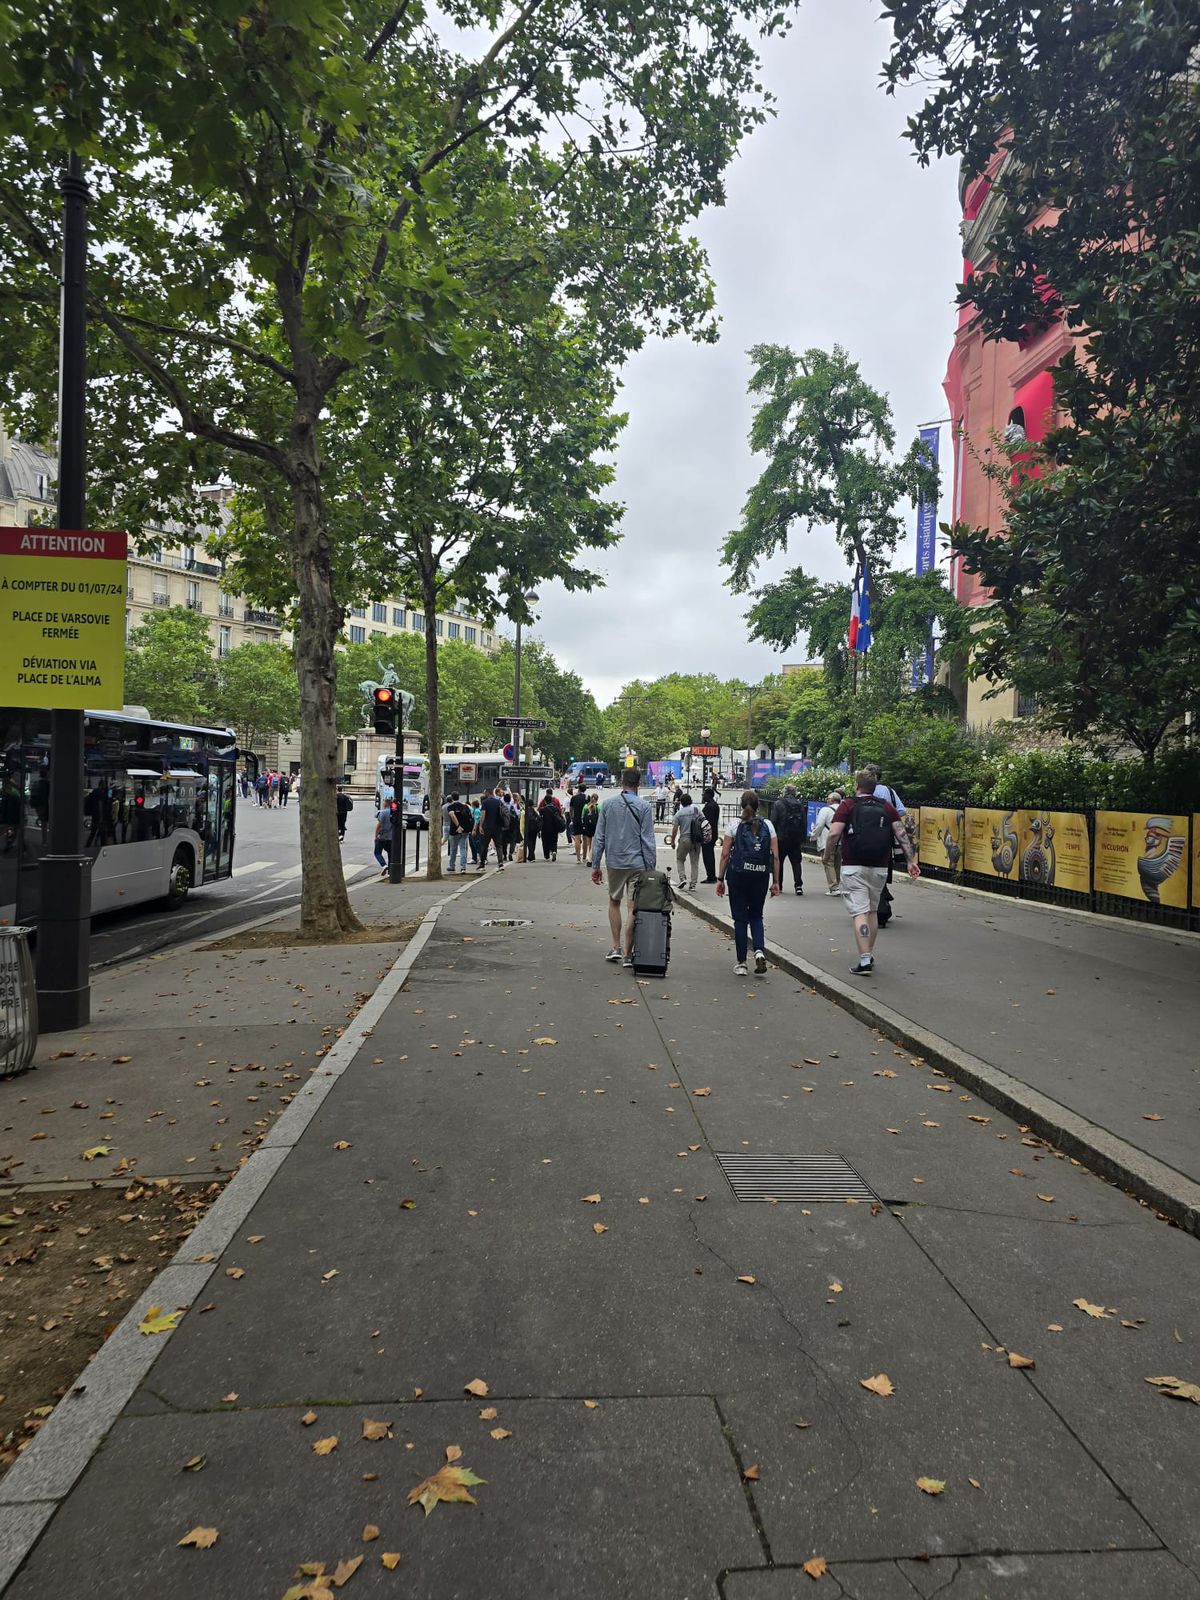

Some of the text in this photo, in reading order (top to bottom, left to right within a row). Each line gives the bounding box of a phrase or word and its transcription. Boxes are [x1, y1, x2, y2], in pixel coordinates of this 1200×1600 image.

[20, 534, 105, 553] ATTENTION
[920, 551, 930, 571] arts
[1, 577, 123, 596] À COMPTER DU 01/07/24
[12, 611, 110, 625] PLACE DE VARSOVIE
[42, 625, 80, 639] FERMÉE
[22, 655, 97, 671] DÉVIATION VIA
[17, 673, 102, 686] PLACE DE L'ALMA
[1102, 842, 1129, 853] INCLUSION
[743, 861, 767, 872] ICELAND
